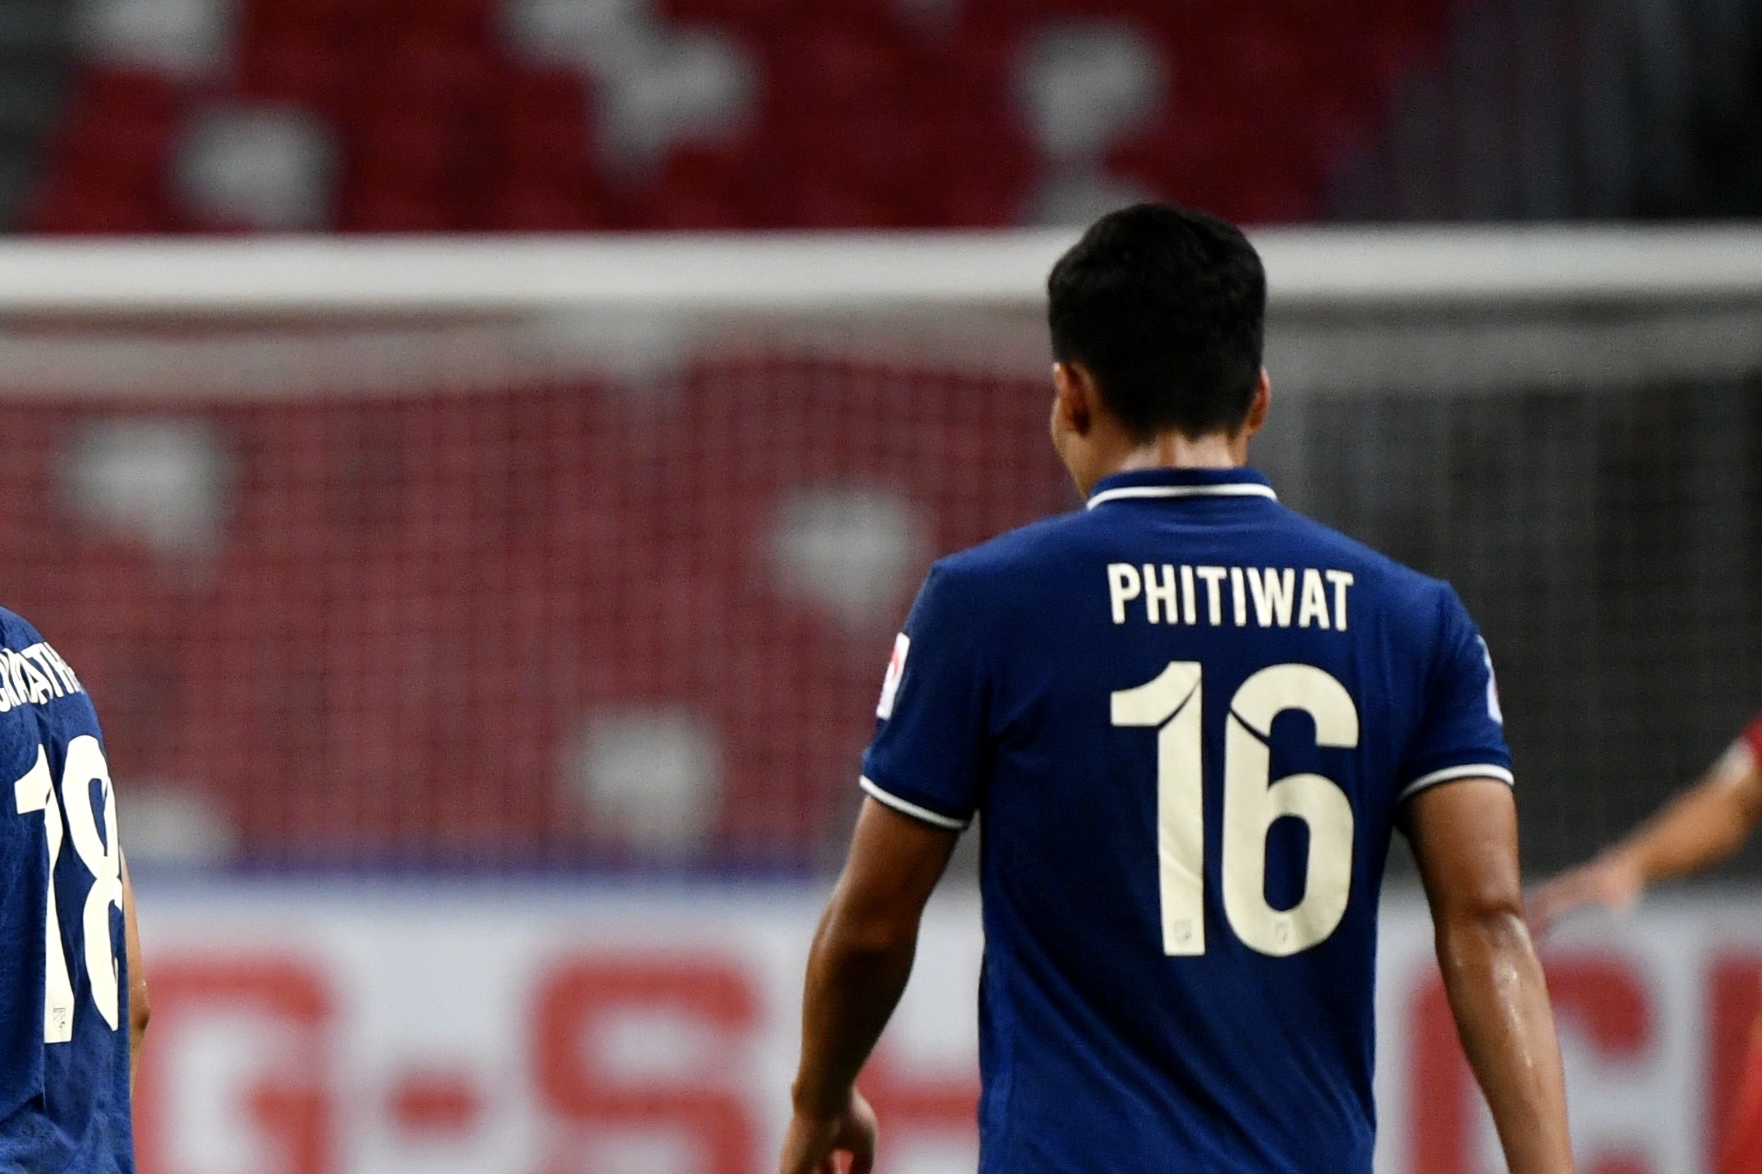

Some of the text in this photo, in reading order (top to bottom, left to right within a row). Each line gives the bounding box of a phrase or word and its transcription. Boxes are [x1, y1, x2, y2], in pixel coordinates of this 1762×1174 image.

[1107, 563, 1354, 631] PHITIWAT
[14, 735, 123, 1044] 18
[1110, 660, 1359, 957] 16
